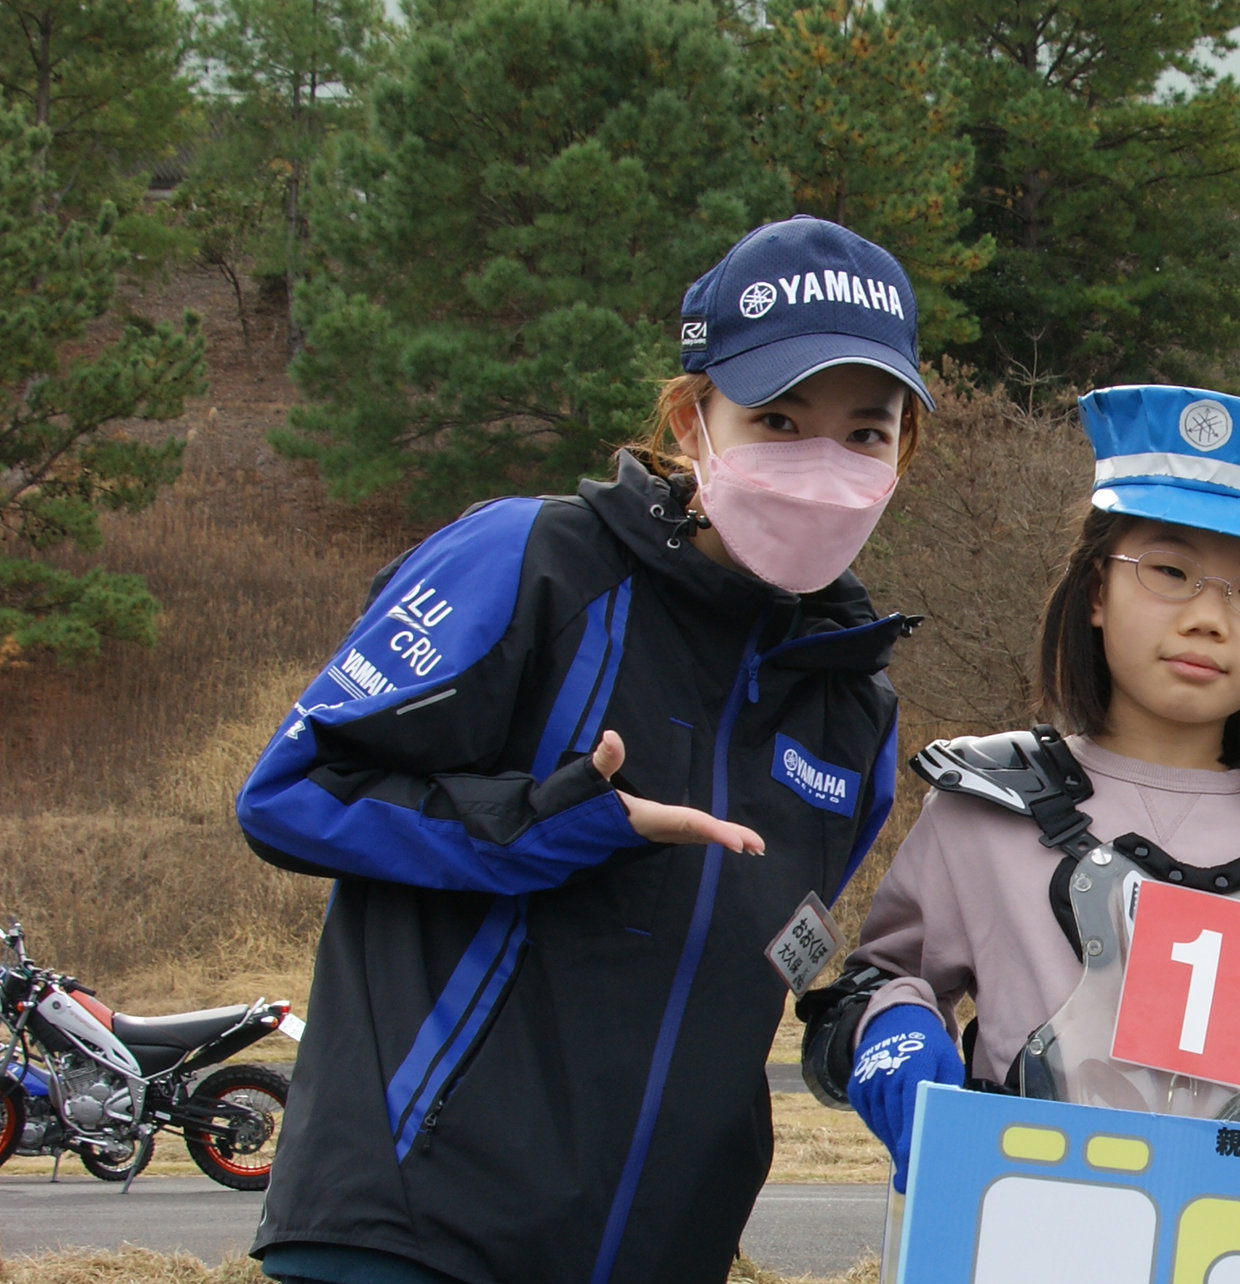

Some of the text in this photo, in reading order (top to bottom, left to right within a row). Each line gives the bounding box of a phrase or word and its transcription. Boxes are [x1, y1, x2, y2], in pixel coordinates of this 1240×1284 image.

[779, 270, 904, 320] YAMAHA
[785, 770, 840, 804] RACING
[796, 755, 846, 798] YAMAHA
[1170, 928, 1223, 1055] 1
